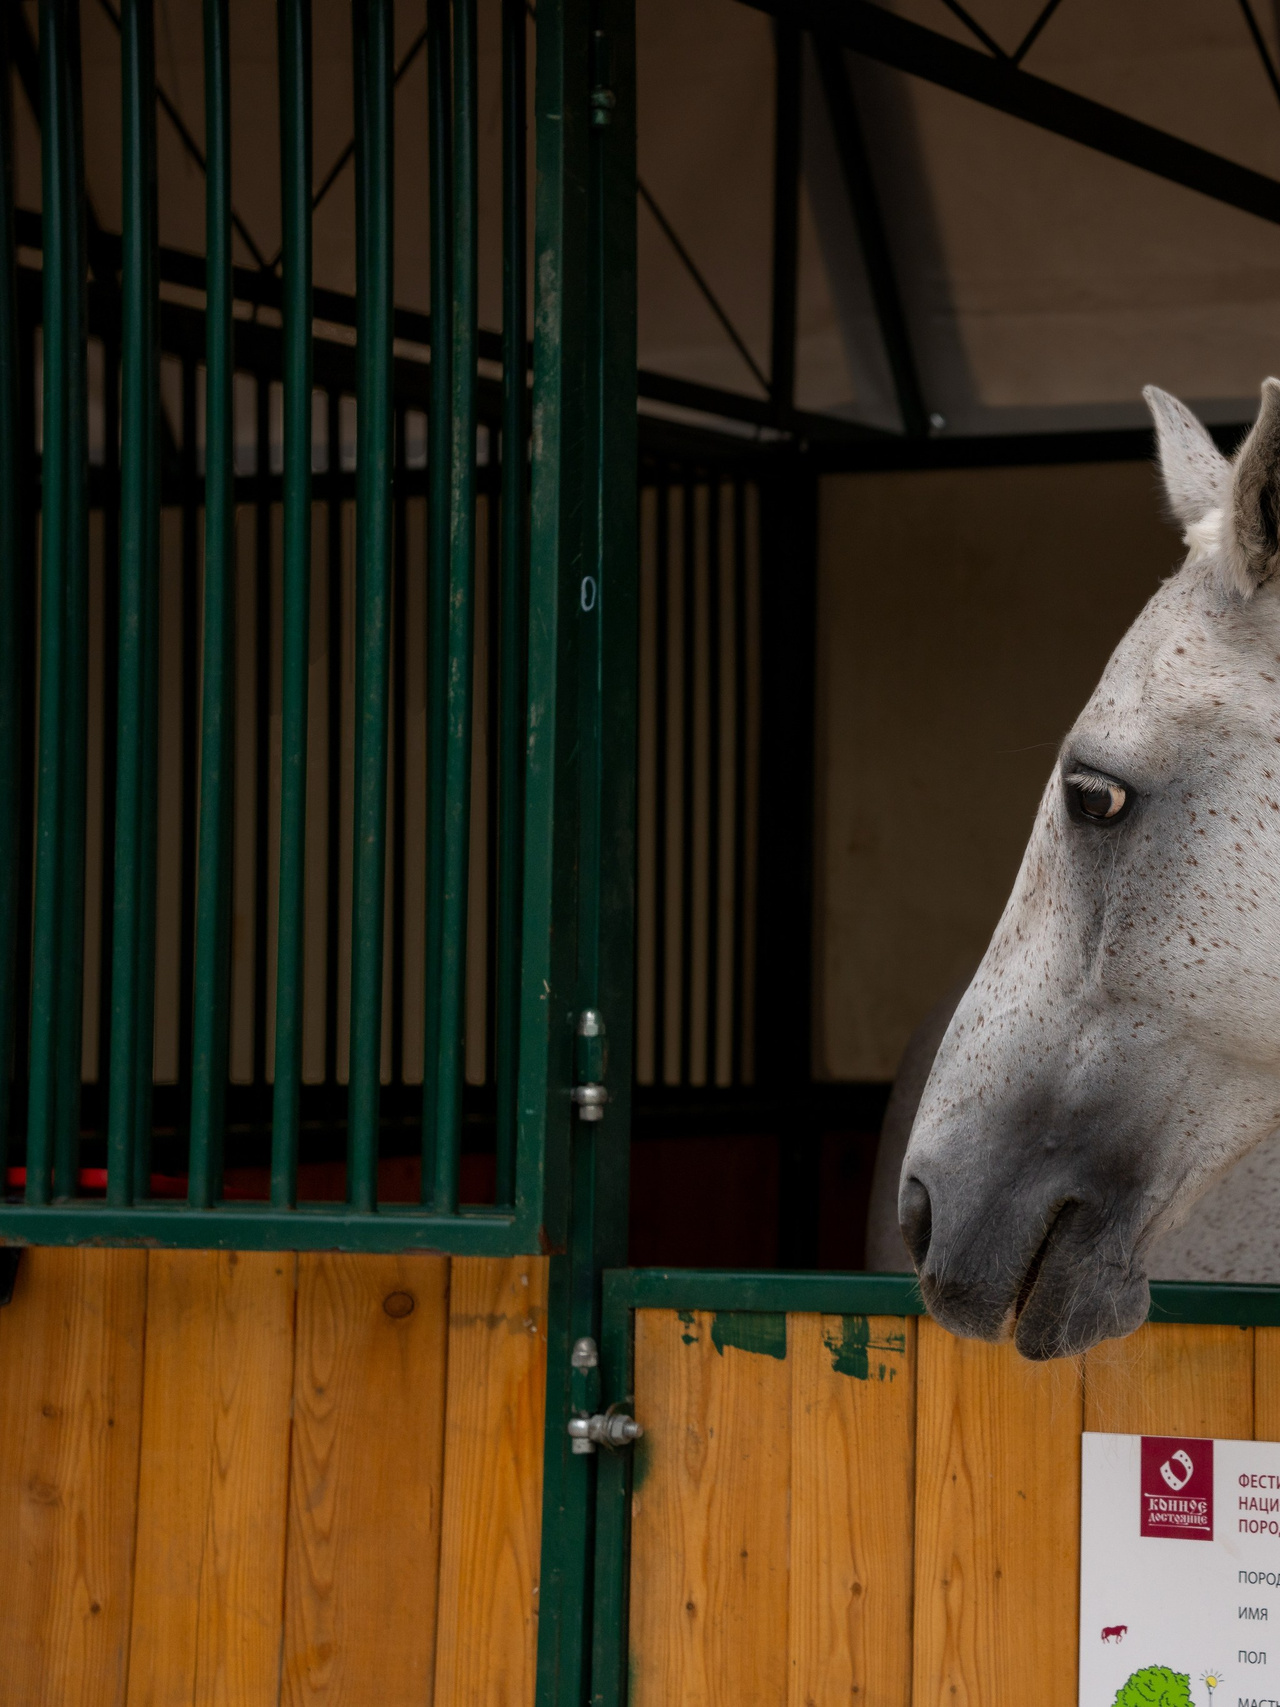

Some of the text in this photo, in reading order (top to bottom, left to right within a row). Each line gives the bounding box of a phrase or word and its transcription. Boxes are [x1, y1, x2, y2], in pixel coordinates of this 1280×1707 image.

[1147, 1498, 1207, 1515] КОННОЕ
[1238, 1607, 1268, 1621] ИМЯ
[1238, 1650, 1267, 1665] ПОЛ
